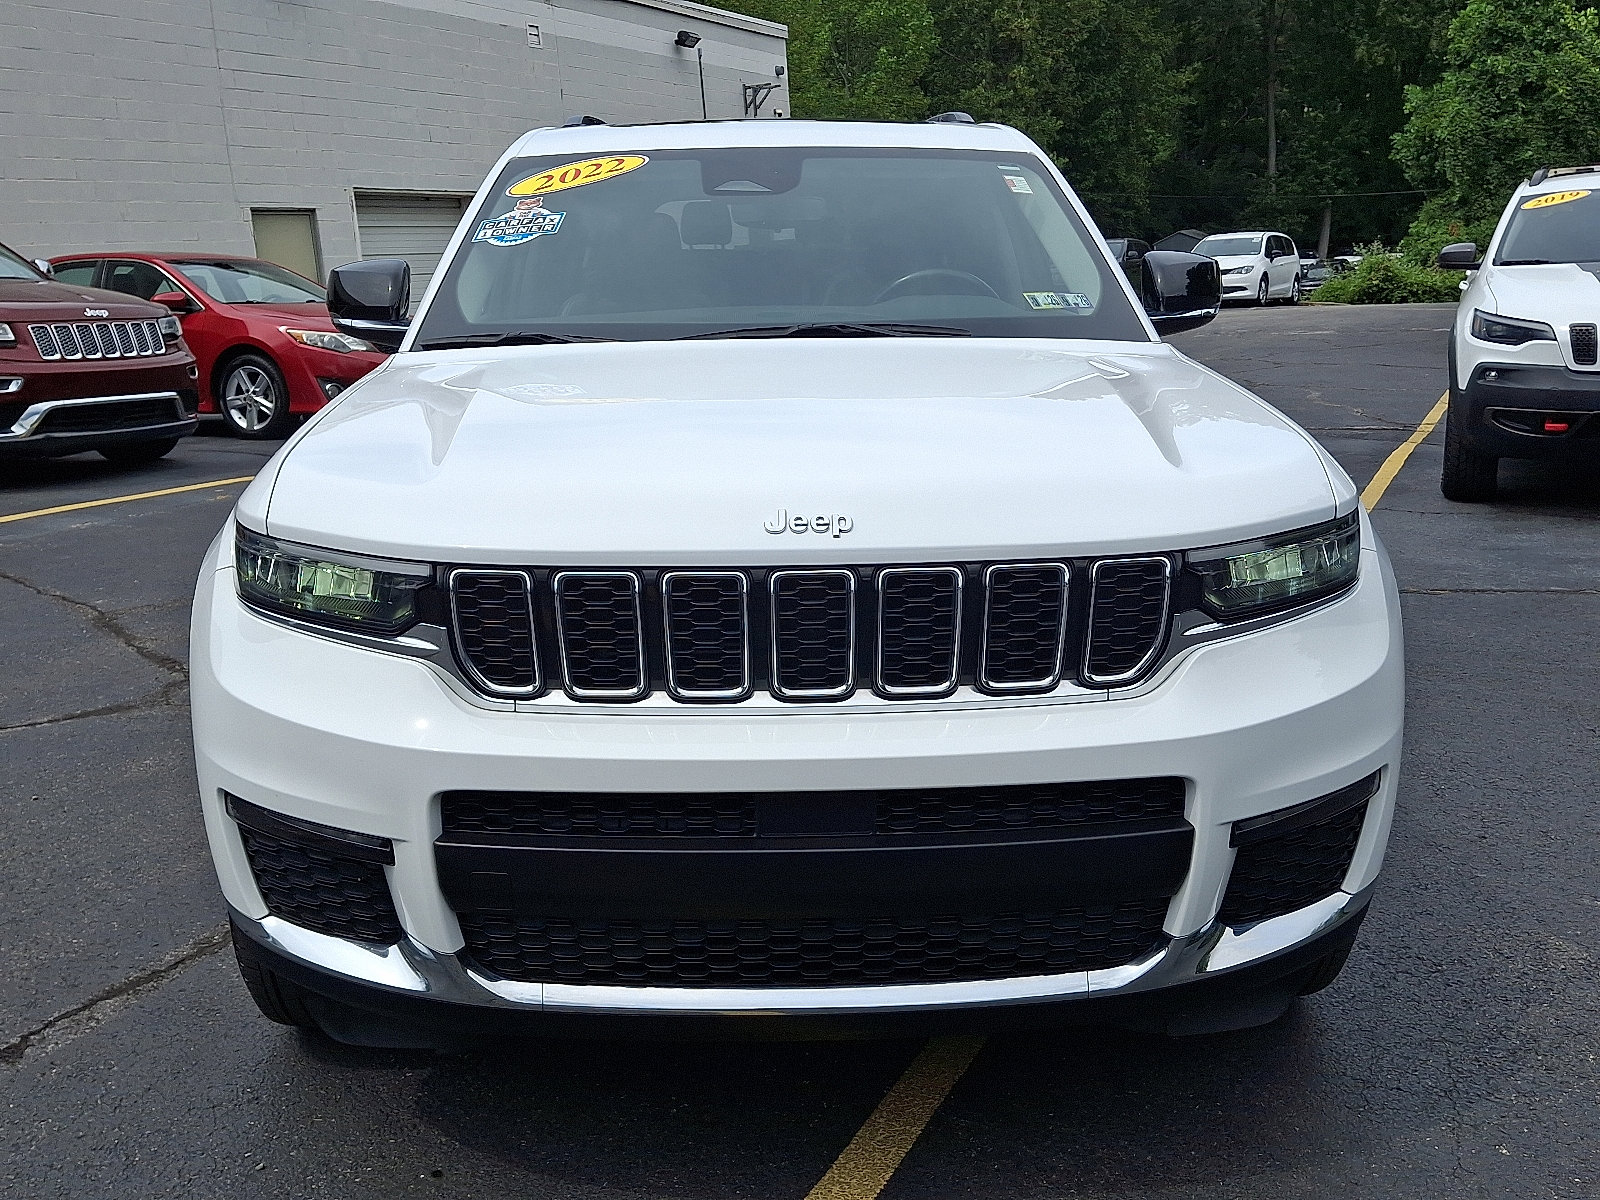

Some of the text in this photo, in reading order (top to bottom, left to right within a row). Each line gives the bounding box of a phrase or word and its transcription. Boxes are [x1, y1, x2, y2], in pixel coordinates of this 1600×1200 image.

[533, 158, 625, 192] 2022
[1533, 191, 1580, 207] 2019
[483, 216, 558, 229] CARFAX
[491, 223, 556, 236] OWNER
[83, 307, 109, 318] Jeep
[763, 508, 854, 539] Jeep
